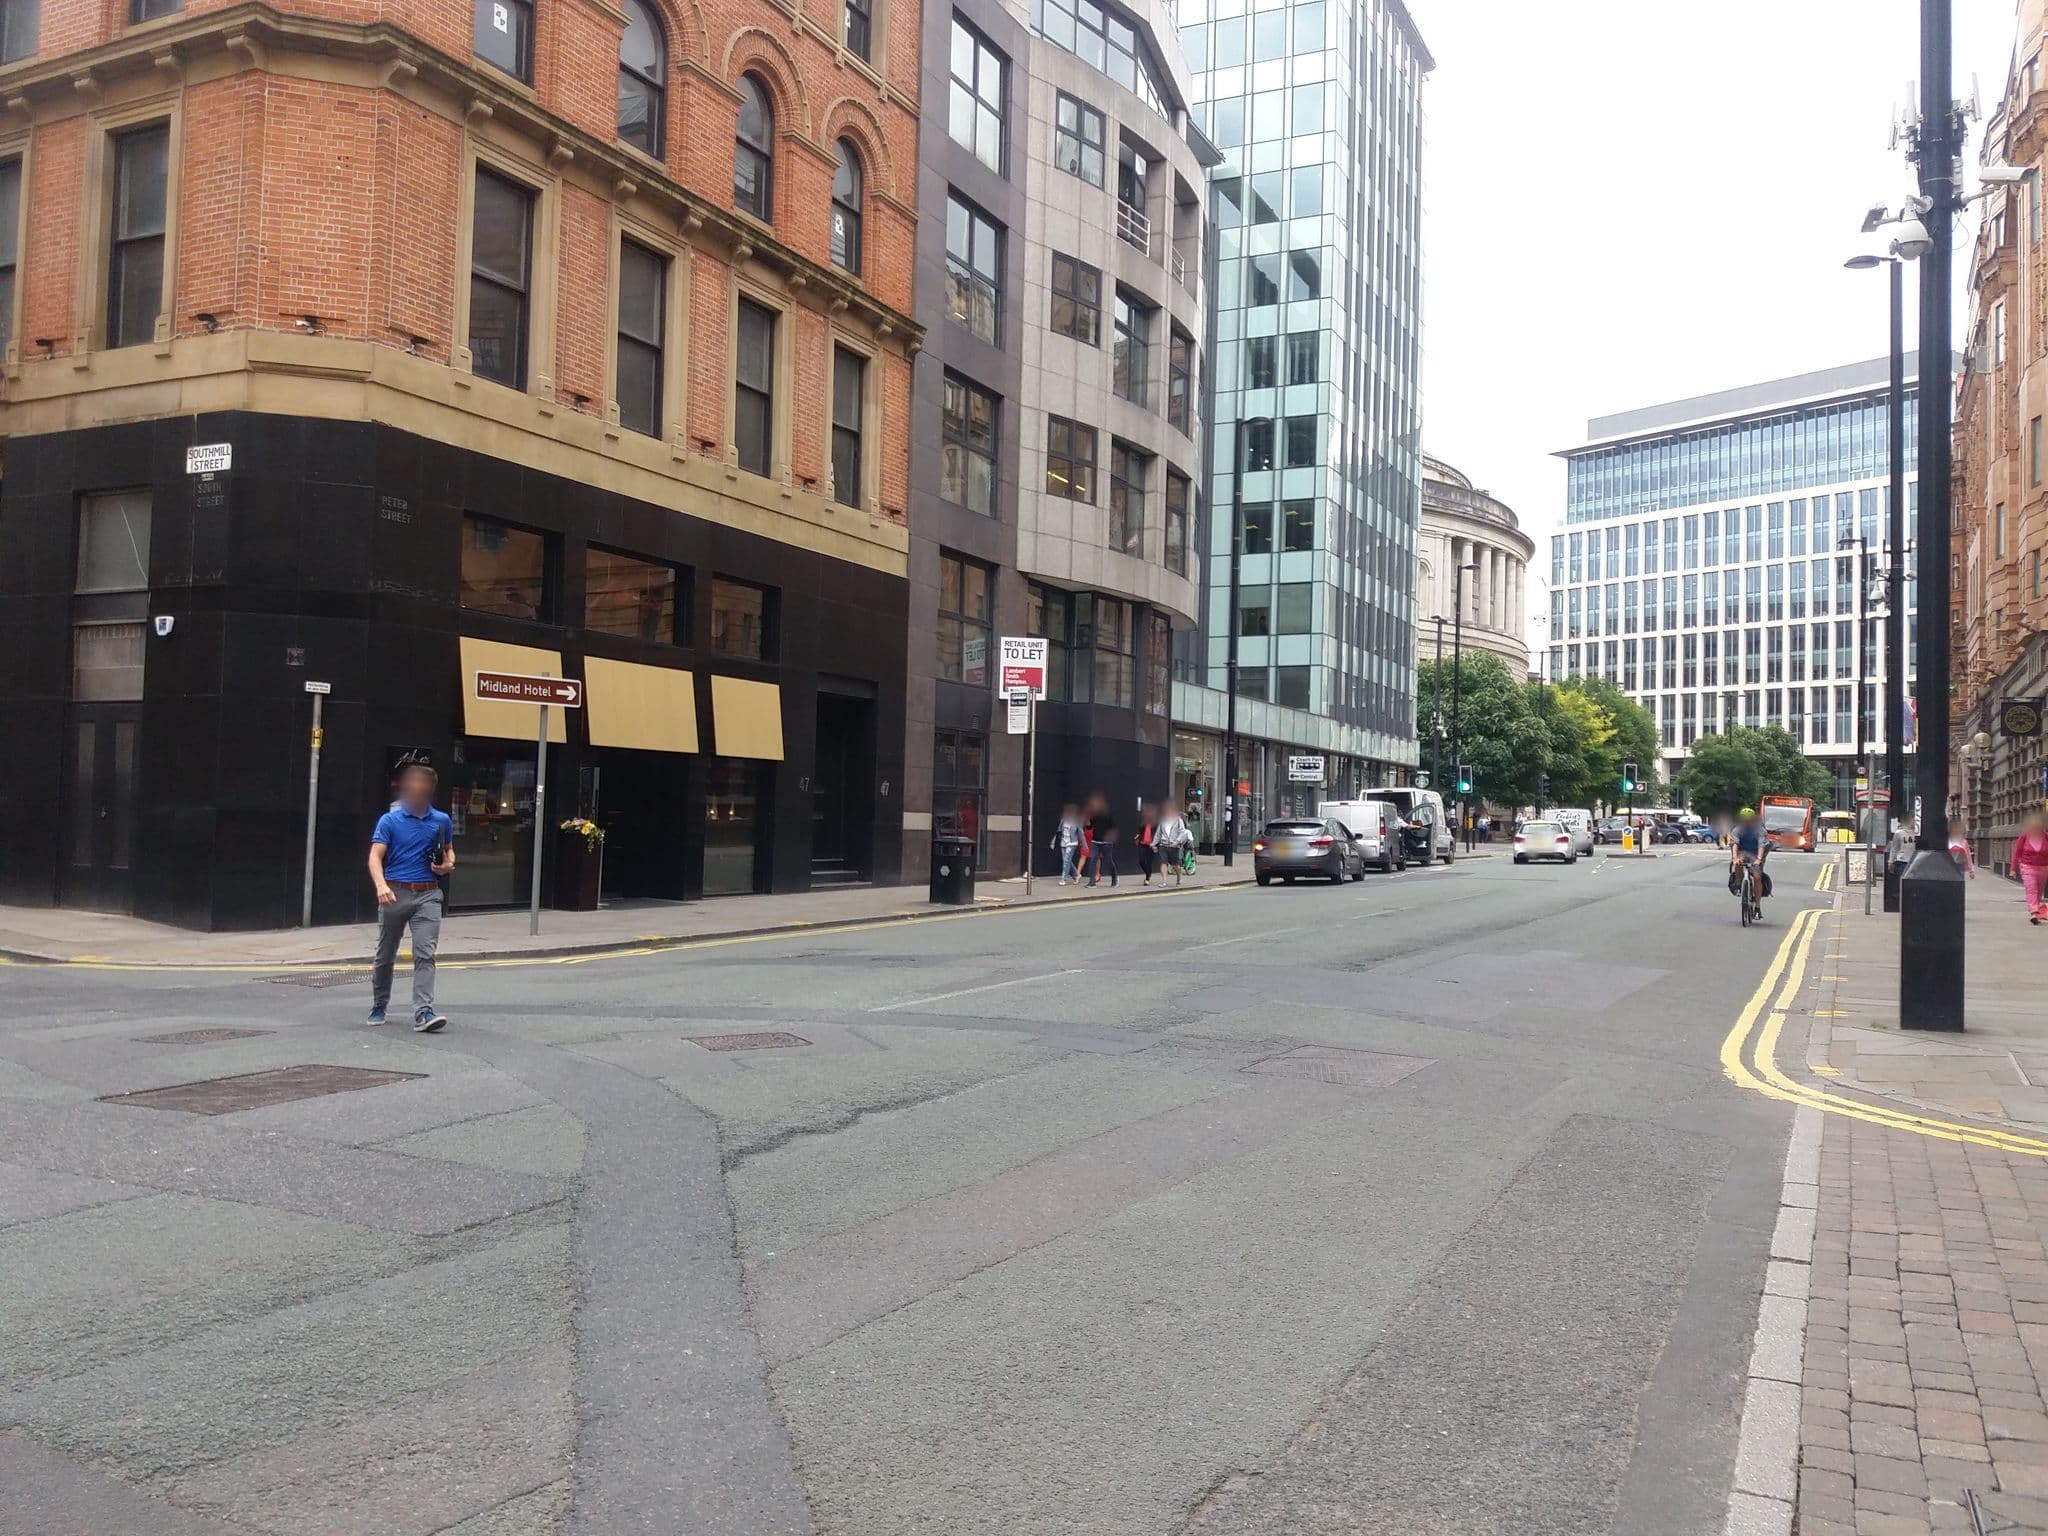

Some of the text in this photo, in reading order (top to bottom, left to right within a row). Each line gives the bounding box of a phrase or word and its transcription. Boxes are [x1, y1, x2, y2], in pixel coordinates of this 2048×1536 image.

[188, 445, 231, 459] SOUTHMILL
[194, 458, 225, 471] STREET
[382, 495, 408, 510] PETER
[380, 508, 411, 524] STREET
[1004, 640, 1044, 649] RETAIL UNIT
[1004, 648, 1044, 660] TO LET
[480, 679, 552, 697] Midland Hotel
